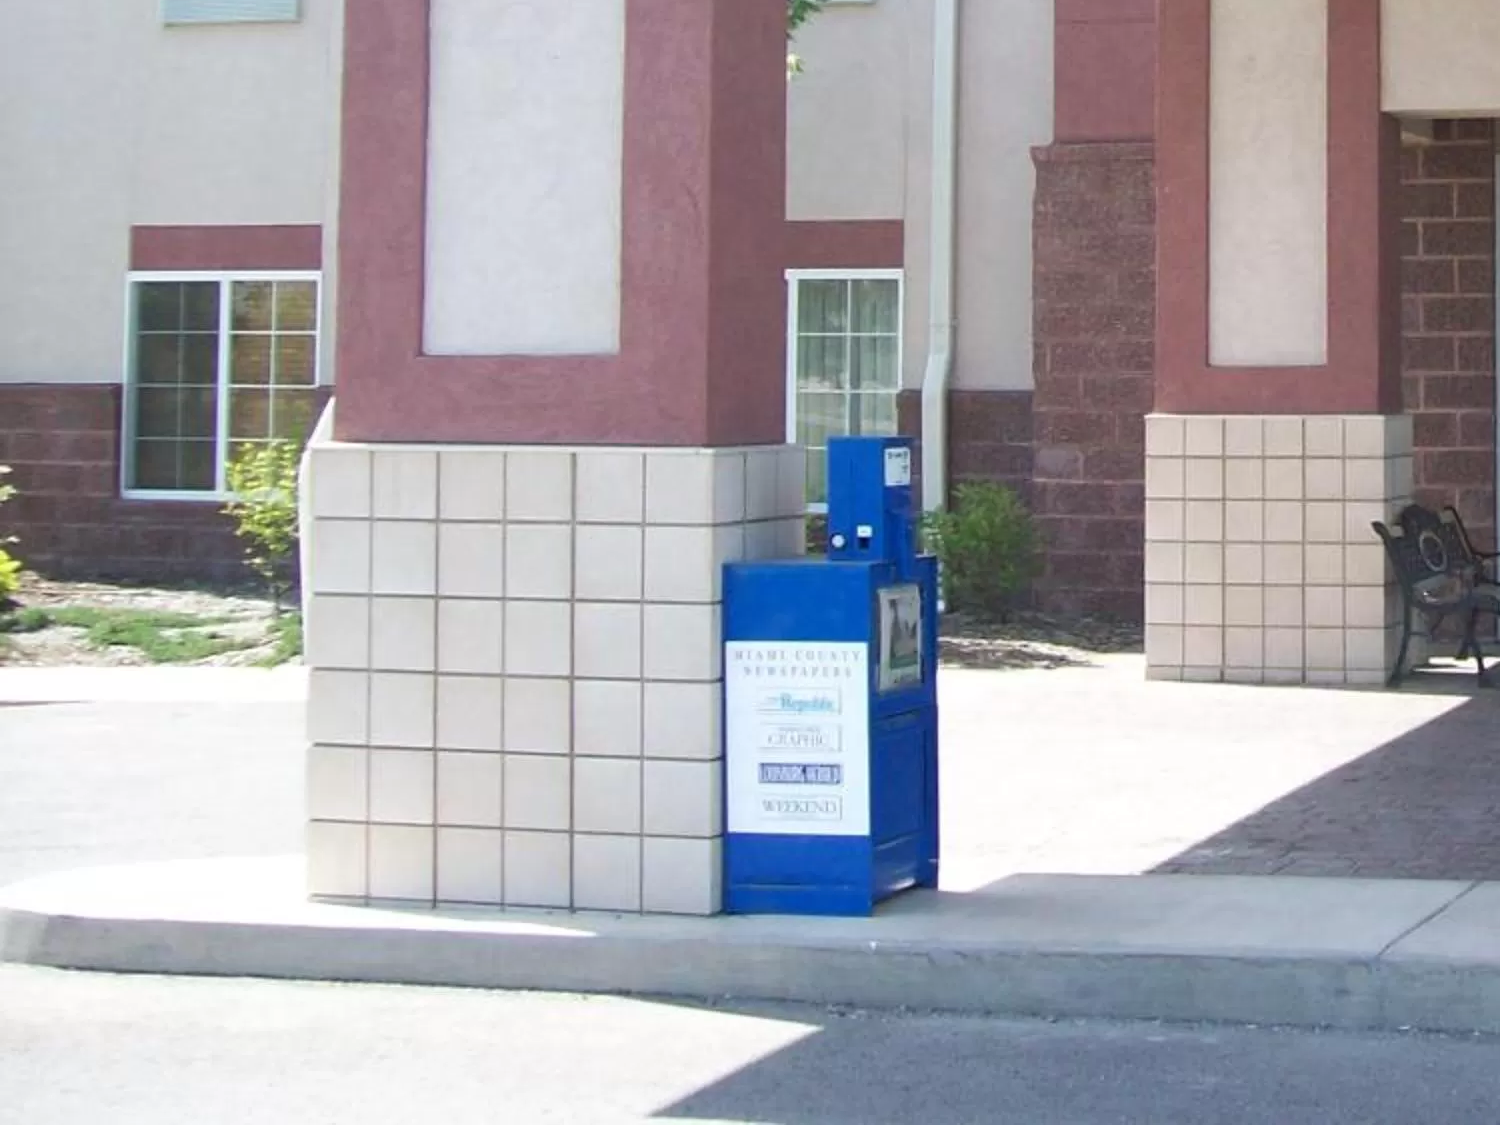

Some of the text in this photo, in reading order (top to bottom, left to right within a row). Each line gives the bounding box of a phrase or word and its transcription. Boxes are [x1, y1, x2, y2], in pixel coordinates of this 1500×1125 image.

[735, 650, 861, 662] MIAMI COUNTY
[743, 666, 853, 678] NEWSPAPERS
[762, 799, 837, 813] WEEKEND
